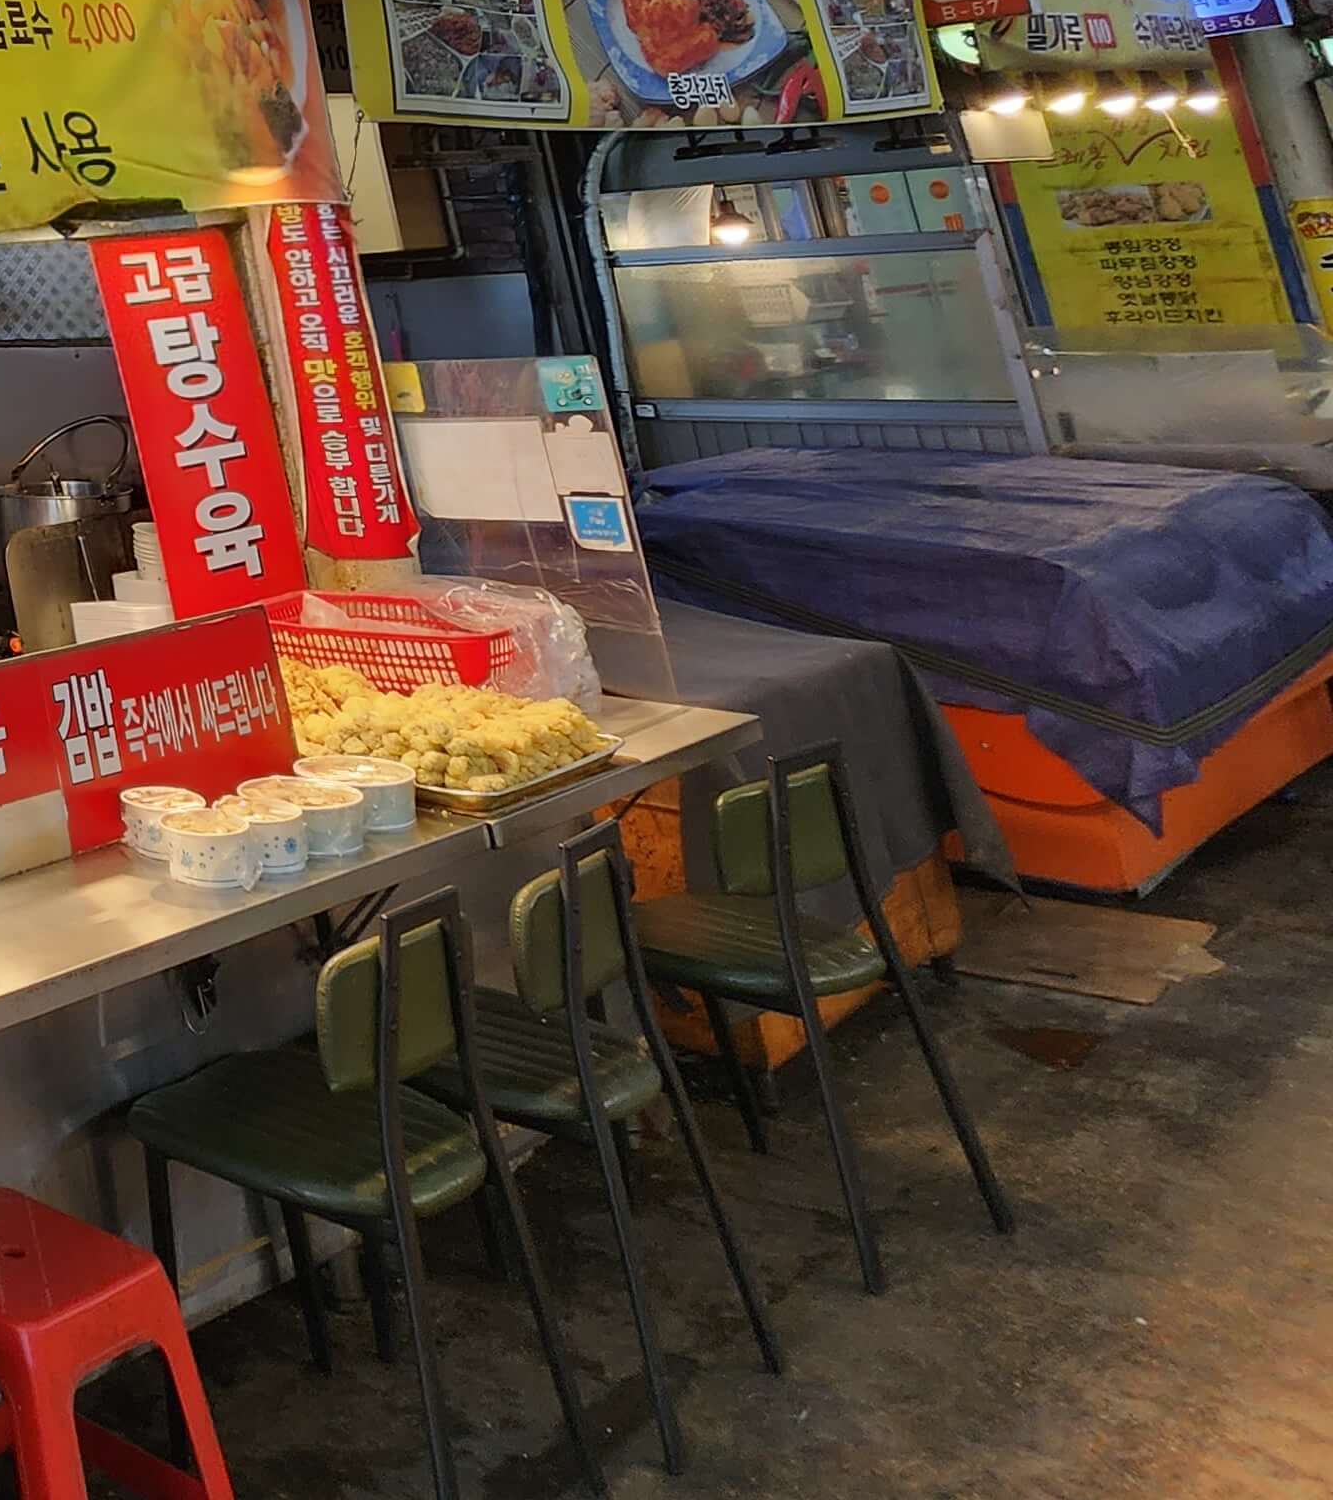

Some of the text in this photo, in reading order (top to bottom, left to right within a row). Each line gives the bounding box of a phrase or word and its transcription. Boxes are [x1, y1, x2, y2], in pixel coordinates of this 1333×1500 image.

[60, 1, 136, 53] 2,000
[1201, 13, 1256, 33] B-56
[20, 110, 119, 188] 사용
[118, 244, 214, 306] 고급
[303, 357, 344, 425] 맛으로
[144, 310, 267, 578] 탕수육
[320, 430, 353, 471] 승부
[327, 476, 365, 539] 합니다
[51, 668, 122, 786] 김밥
[120, 682, 199, 764] 즉석에서
[194, 661, 282, 744] 싸드립니다
